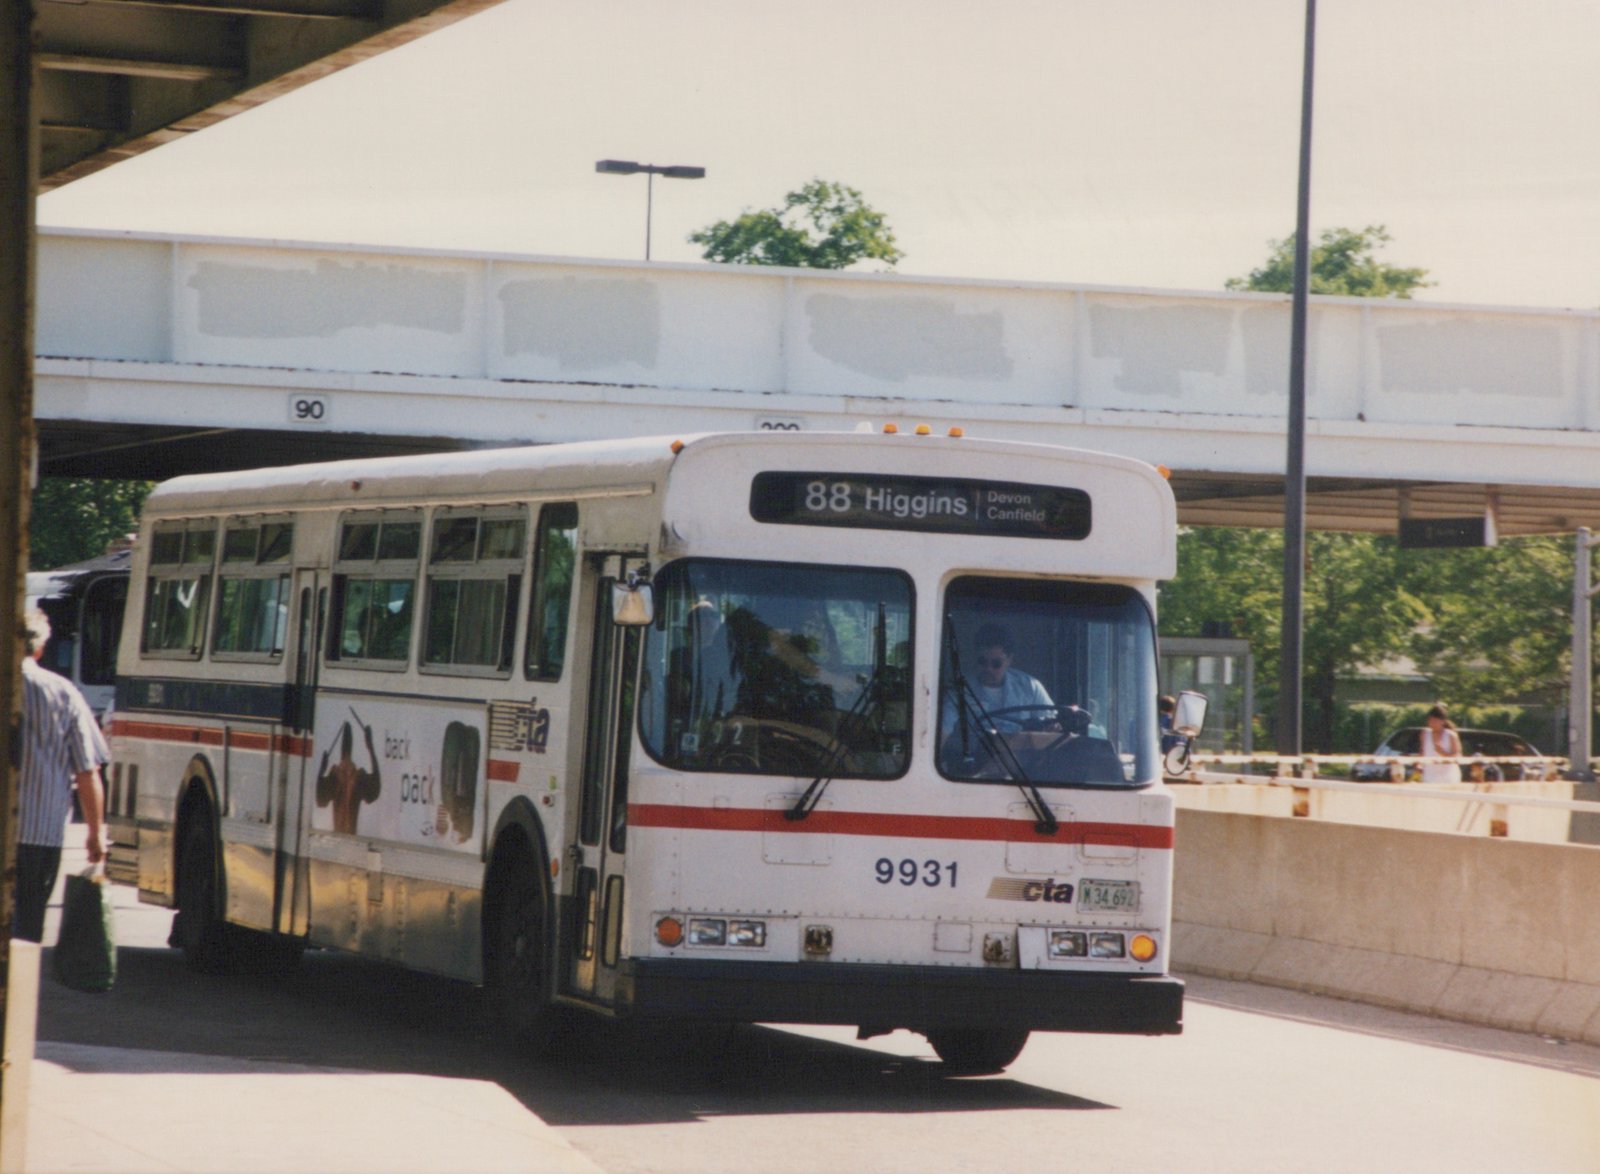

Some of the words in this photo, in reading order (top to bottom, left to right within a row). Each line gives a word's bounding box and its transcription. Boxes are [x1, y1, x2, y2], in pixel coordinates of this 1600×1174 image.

[296, 399, 324, 419] 90
[806, 481, 851, 512] 88
[864, 486, 968, 518] Higgins
[987, 490, 1031, 505] Devon
[986, 507, 1046, 521] Canfield
[384, 729, 411, 760] back
[874, 857, 958, 888] 9931
[1023, 878, 1074, 904] cta
